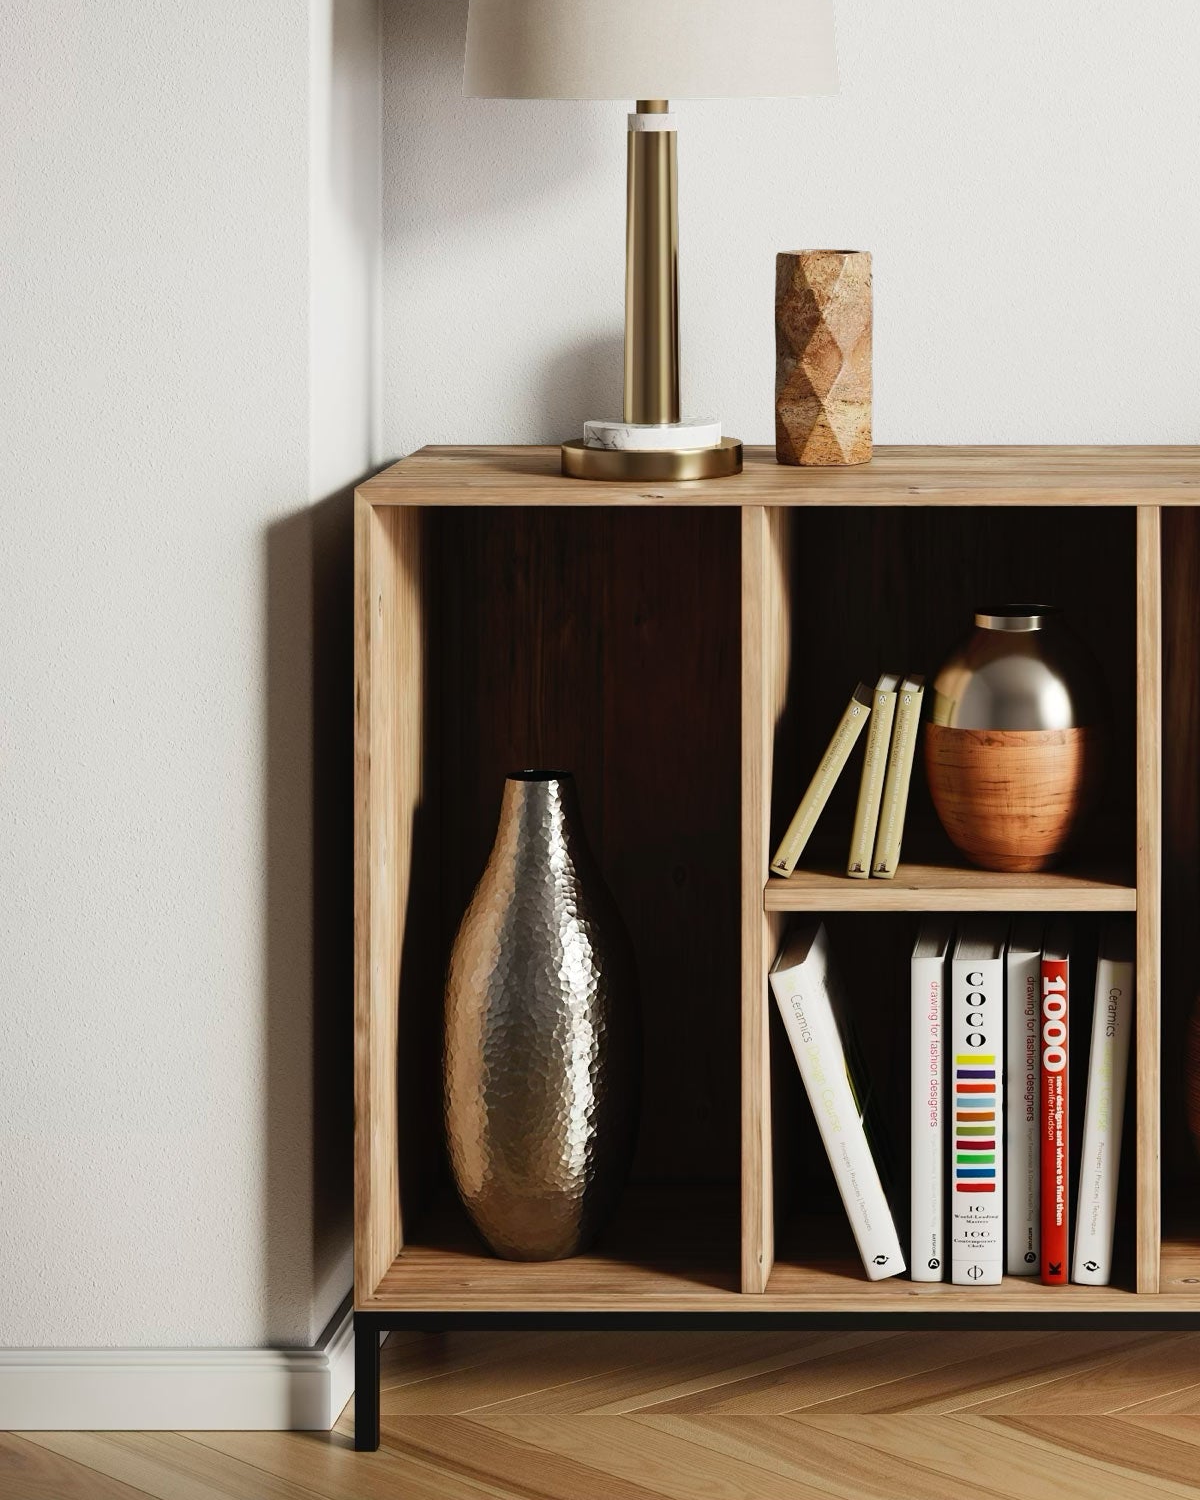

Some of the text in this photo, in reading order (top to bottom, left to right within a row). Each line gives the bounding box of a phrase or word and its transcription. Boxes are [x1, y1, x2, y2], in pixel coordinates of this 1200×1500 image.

[927, 980, 939, 1021] drawing
[965, 971, 987, 1048] COCO
[1105, 988, 1120, 1036] Ceramics
[929, 1022, 940, 1037] for
[929, 1039, 940, 1076] fashion
[1024, 975, 1036, 1122] drawing for fashion designers
[791, 994, 813, 1042] Ceramics
[820, 1087, 841, 1132] Course
[927, 1078, 939, 1127] designers
[1042, 974, 1067, 1226] 1000 new designs and where to find them
[1046, 1075, 1055, 1140] Jennifer Hudson
